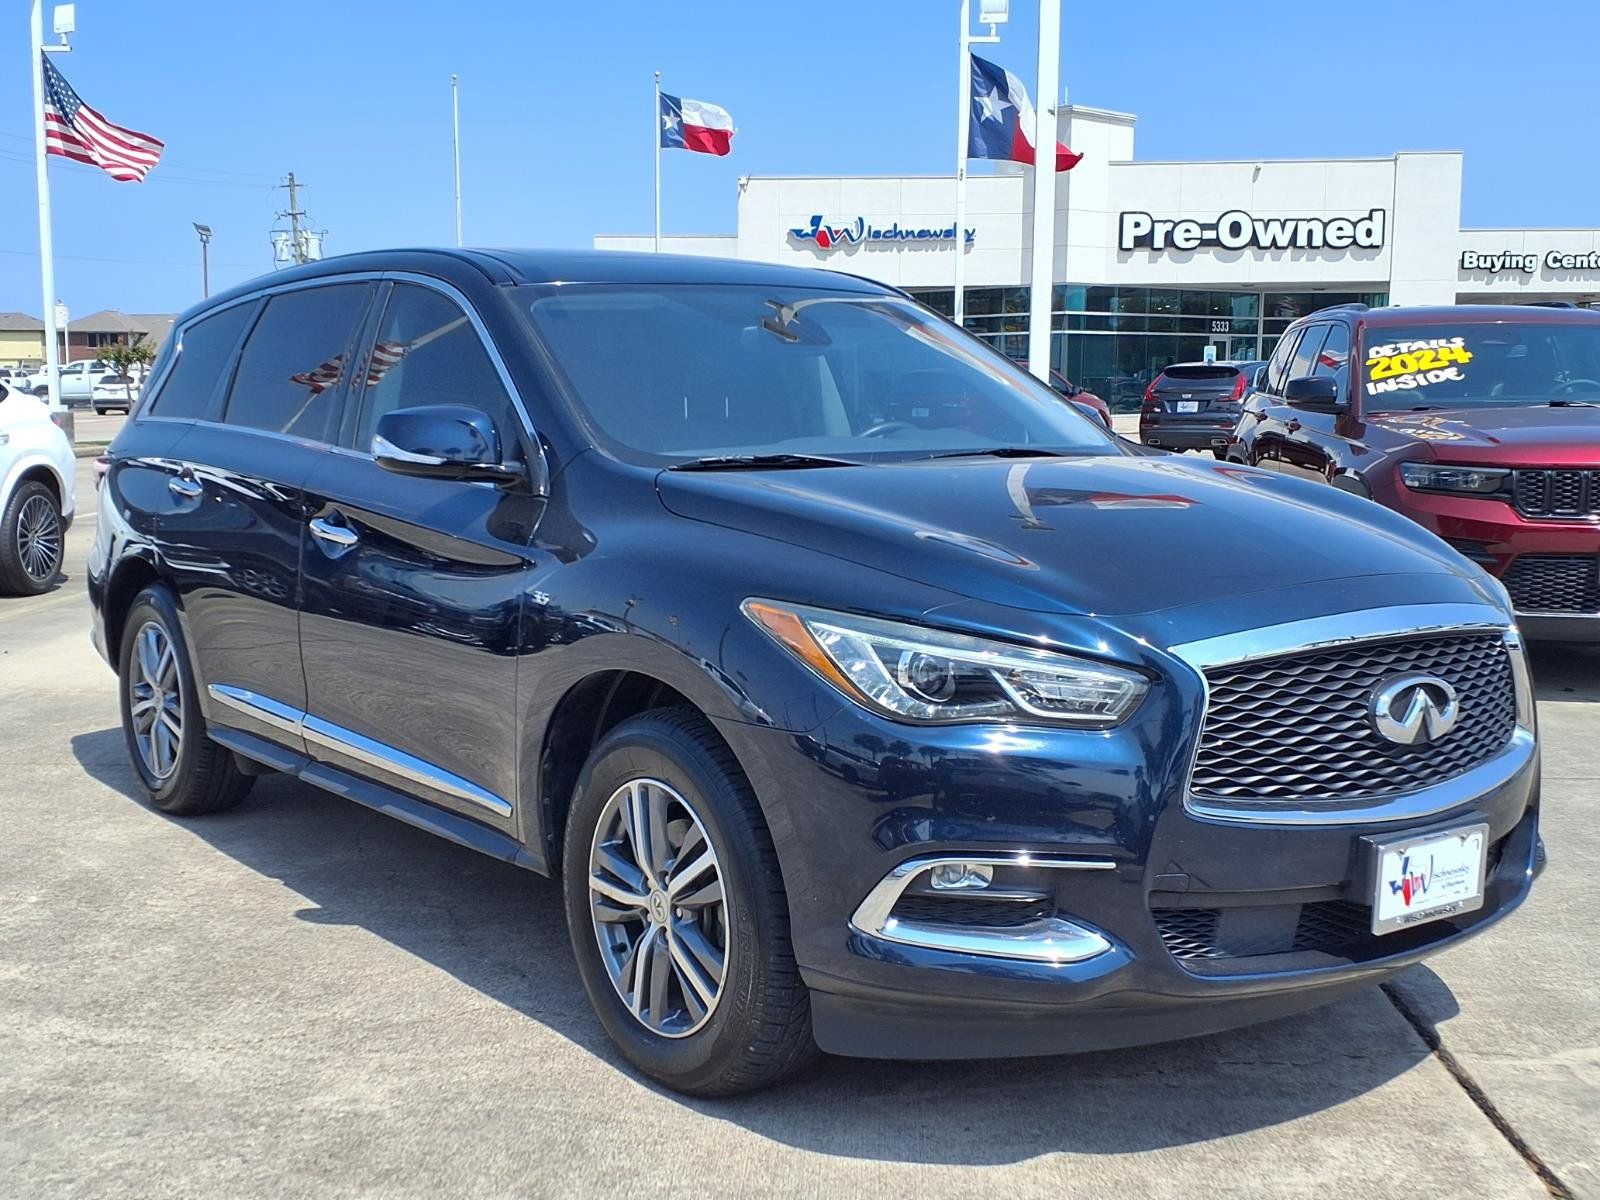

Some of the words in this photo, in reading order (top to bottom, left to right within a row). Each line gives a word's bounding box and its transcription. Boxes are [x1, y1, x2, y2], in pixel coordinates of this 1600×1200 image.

[824, 216, 976, 243] Wischnewsy
[1119, 209, 1386, 251] Pre-Owned
[1462, 250, 1538, 273] Buying
[1211, 320, 1230, 332] 5333
[1368, 336, 1465, 359] DETAILS
[1365, 345, 1473, 381] 2024
[1366, 366, 1466, 396] INSIDE
